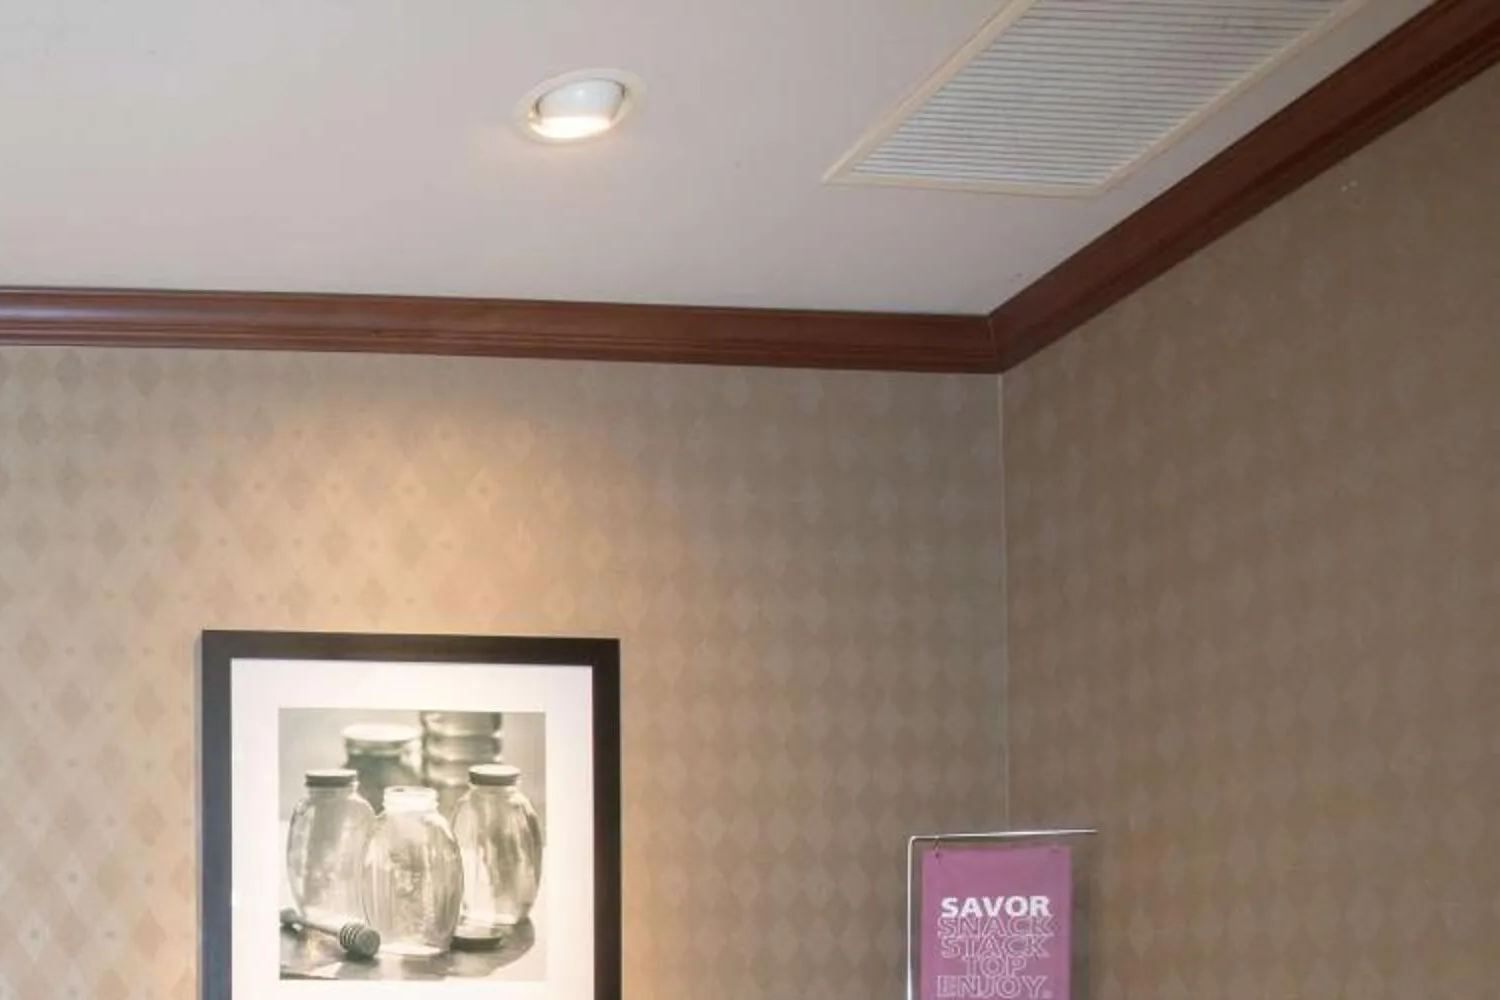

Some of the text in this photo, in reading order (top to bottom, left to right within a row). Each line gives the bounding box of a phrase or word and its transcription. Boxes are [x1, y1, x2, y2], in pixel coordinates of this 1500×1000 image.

[940, 895, 1051, 917] SAVOR
[937, 916, 1054, 937] SNACK
[940, 935, 1050, 958] STACK
[962, 955, 1027, 978] TOP
